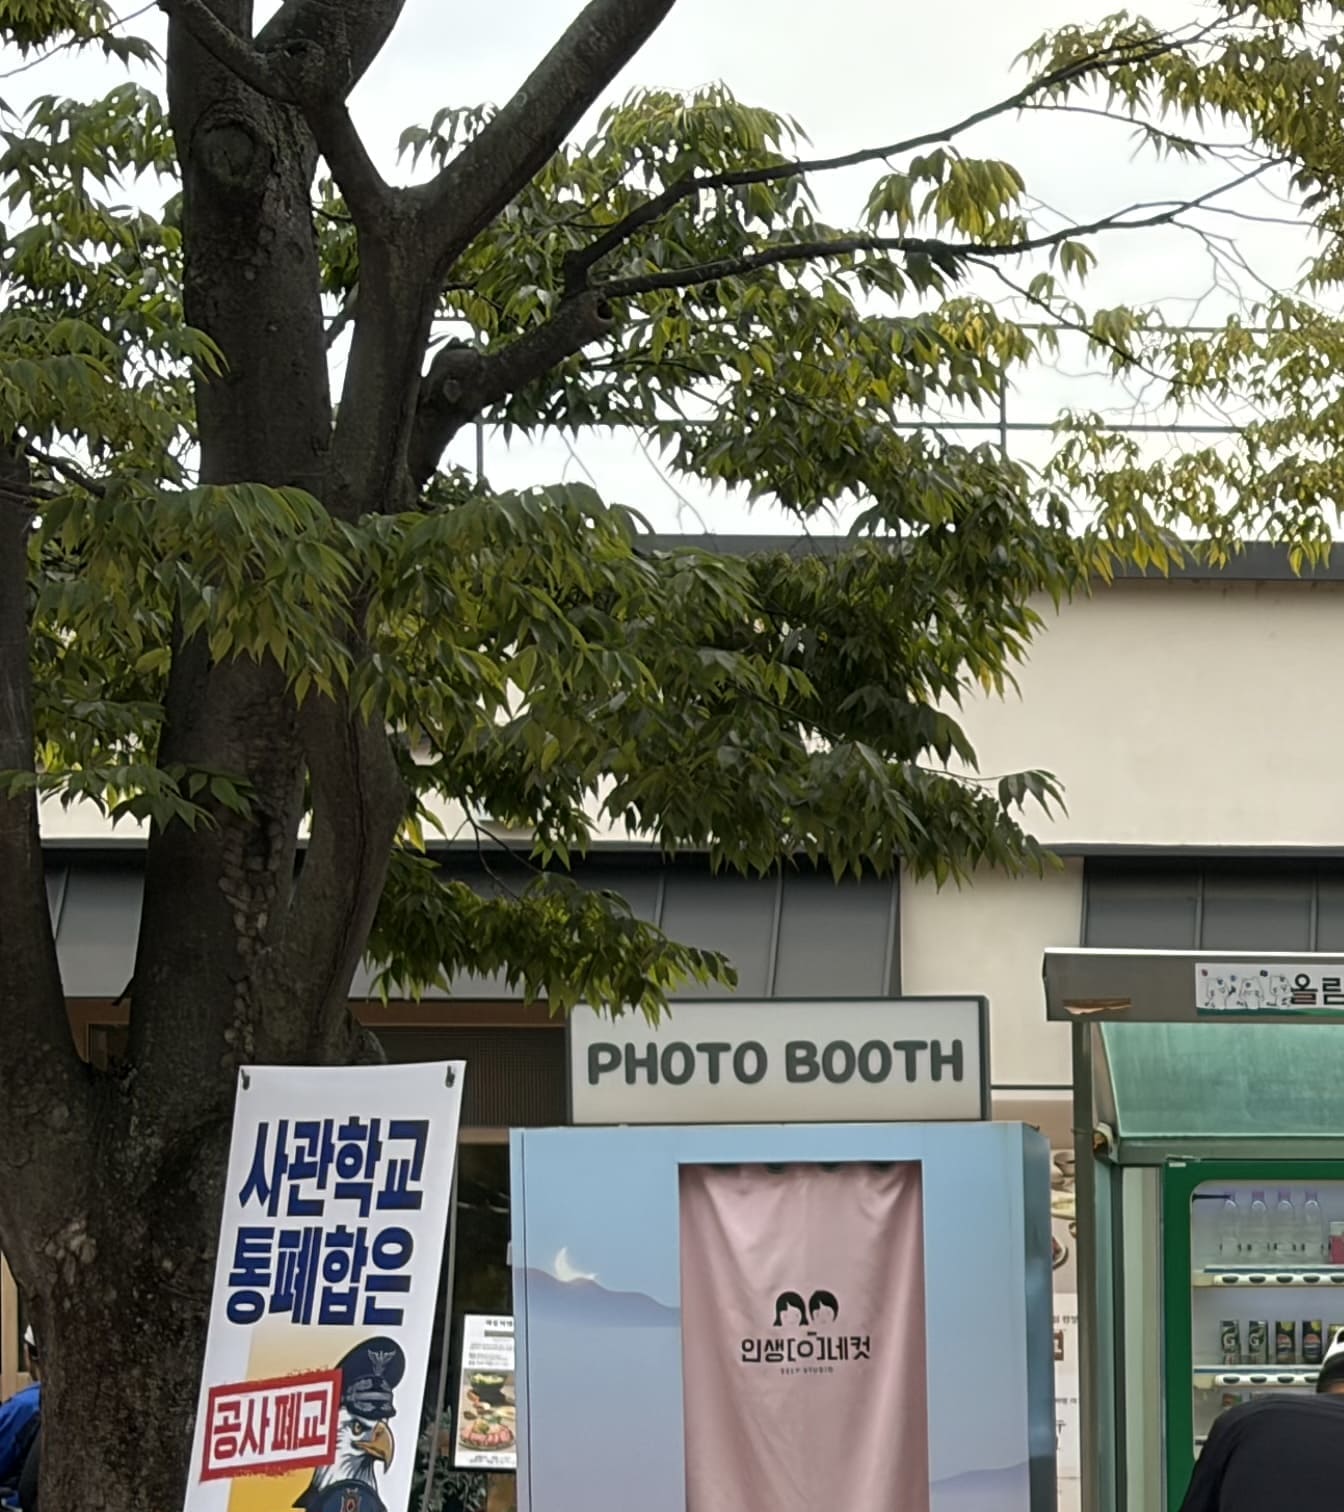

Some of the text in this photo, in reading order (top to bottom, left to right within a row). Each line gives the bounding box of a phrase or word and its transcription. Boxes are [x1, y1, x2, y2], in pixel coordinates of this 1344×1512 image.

[587, 1038, 963, 1086] PHOTO BOOTH
[239, 1116, 429, 1218] 사관학교
[226, 1224, 414, 1327] 통폐합은
[803, 1366, 834, 1374] STUDIO
[213, 1390, 328, 1460] 공사 폐교
